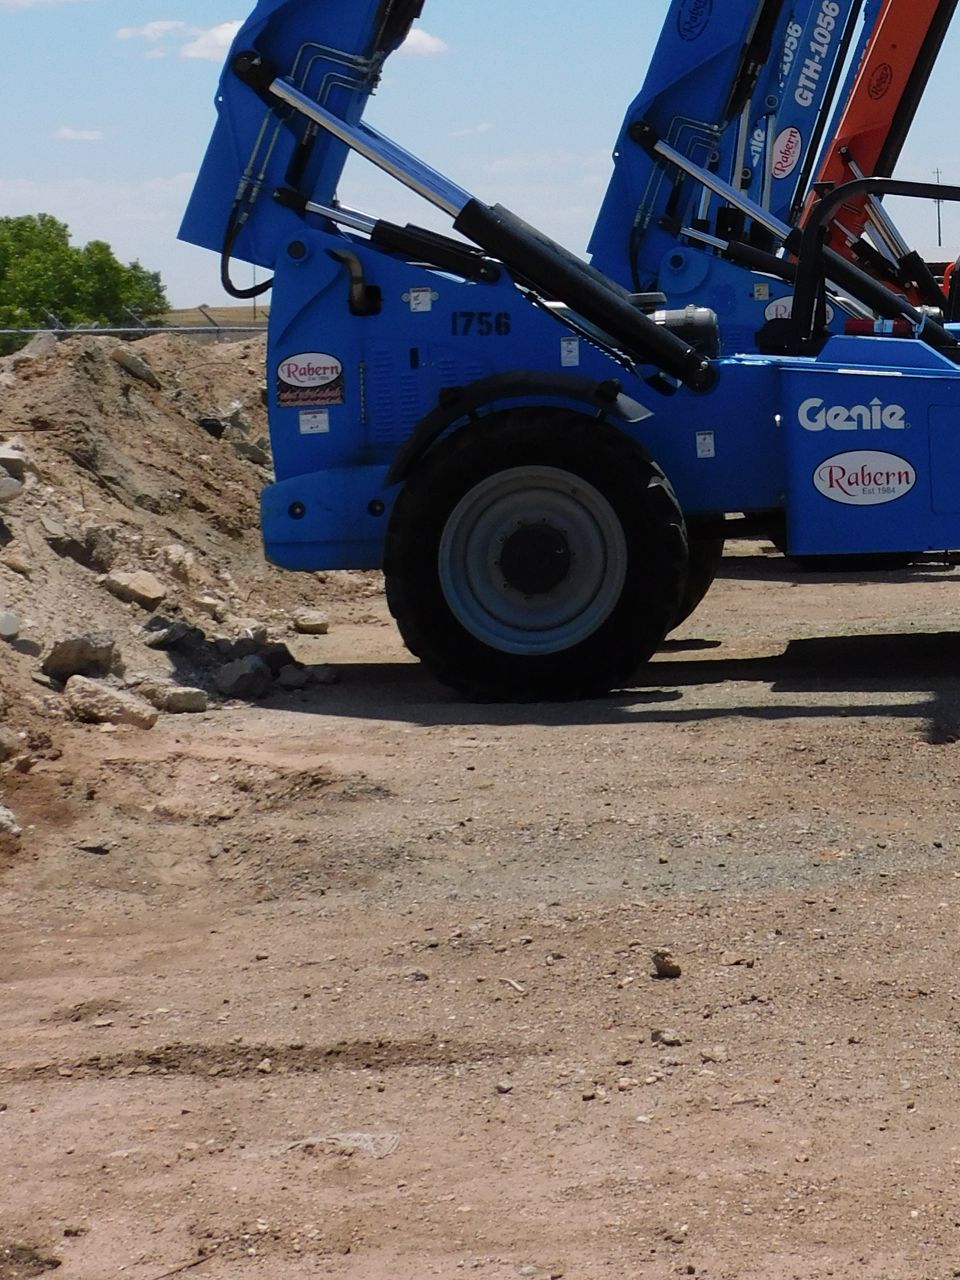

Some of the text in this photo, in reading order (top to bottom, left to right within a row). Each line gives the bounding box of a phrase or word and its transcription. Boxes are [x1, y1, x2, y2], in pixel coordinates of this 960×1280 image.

[794, 0, 840, 107] GTH-1056
[773, 129, 799, 177] Rabern
[452, 311, 511, 336] 1756
[281, 362, 340, 383] Rabern
[798, 397, 906, 431] Genie
[818, 465, 912, 497] Rabern
[862, 487, 896, 495] Est 1984
